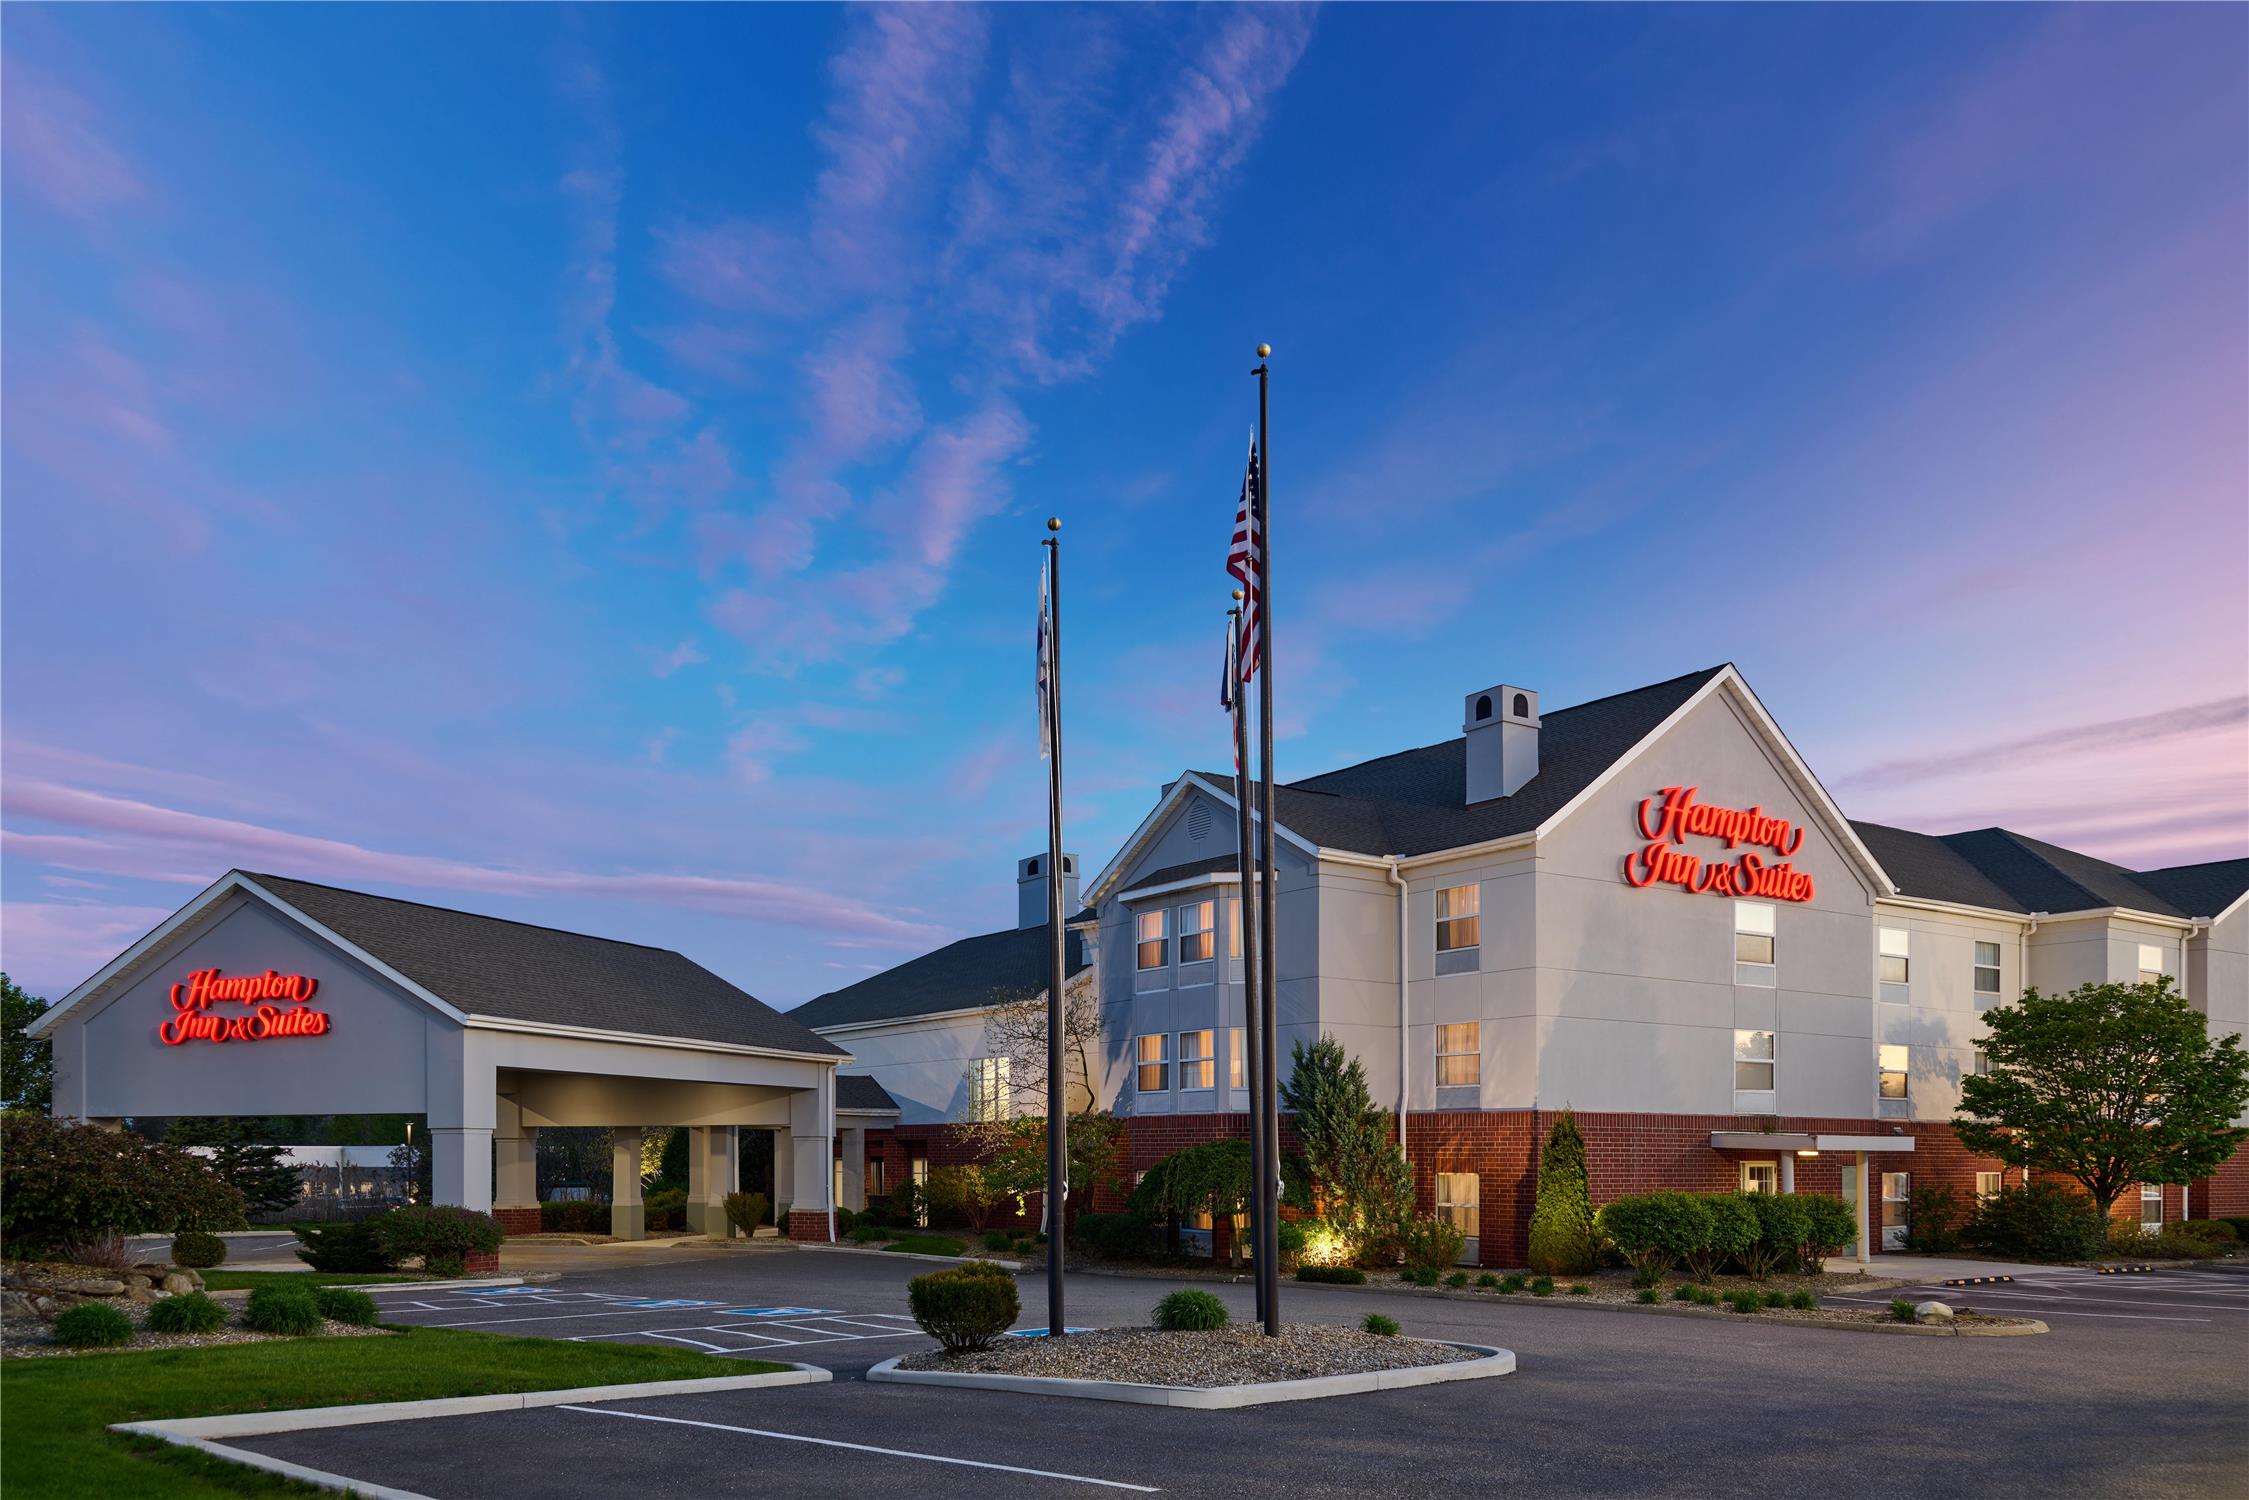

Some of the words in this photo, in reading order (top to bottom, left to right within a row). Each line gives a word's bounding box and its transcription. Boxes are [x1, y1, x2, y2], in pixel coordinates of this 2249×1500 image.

[1638, 785, 1804, 857] Hampton
[1624, 840, 1715, 894] Inn
[1713, 863, 1735, 896] &
[1730, 852, 1815, 902] Suites
[170, 967, 318, 1011] Hampton
[160, 1010, 232, 1045] Inn
[231, 1016, 252, 1040] &
[247, 1006, 329, 1039] Suites
